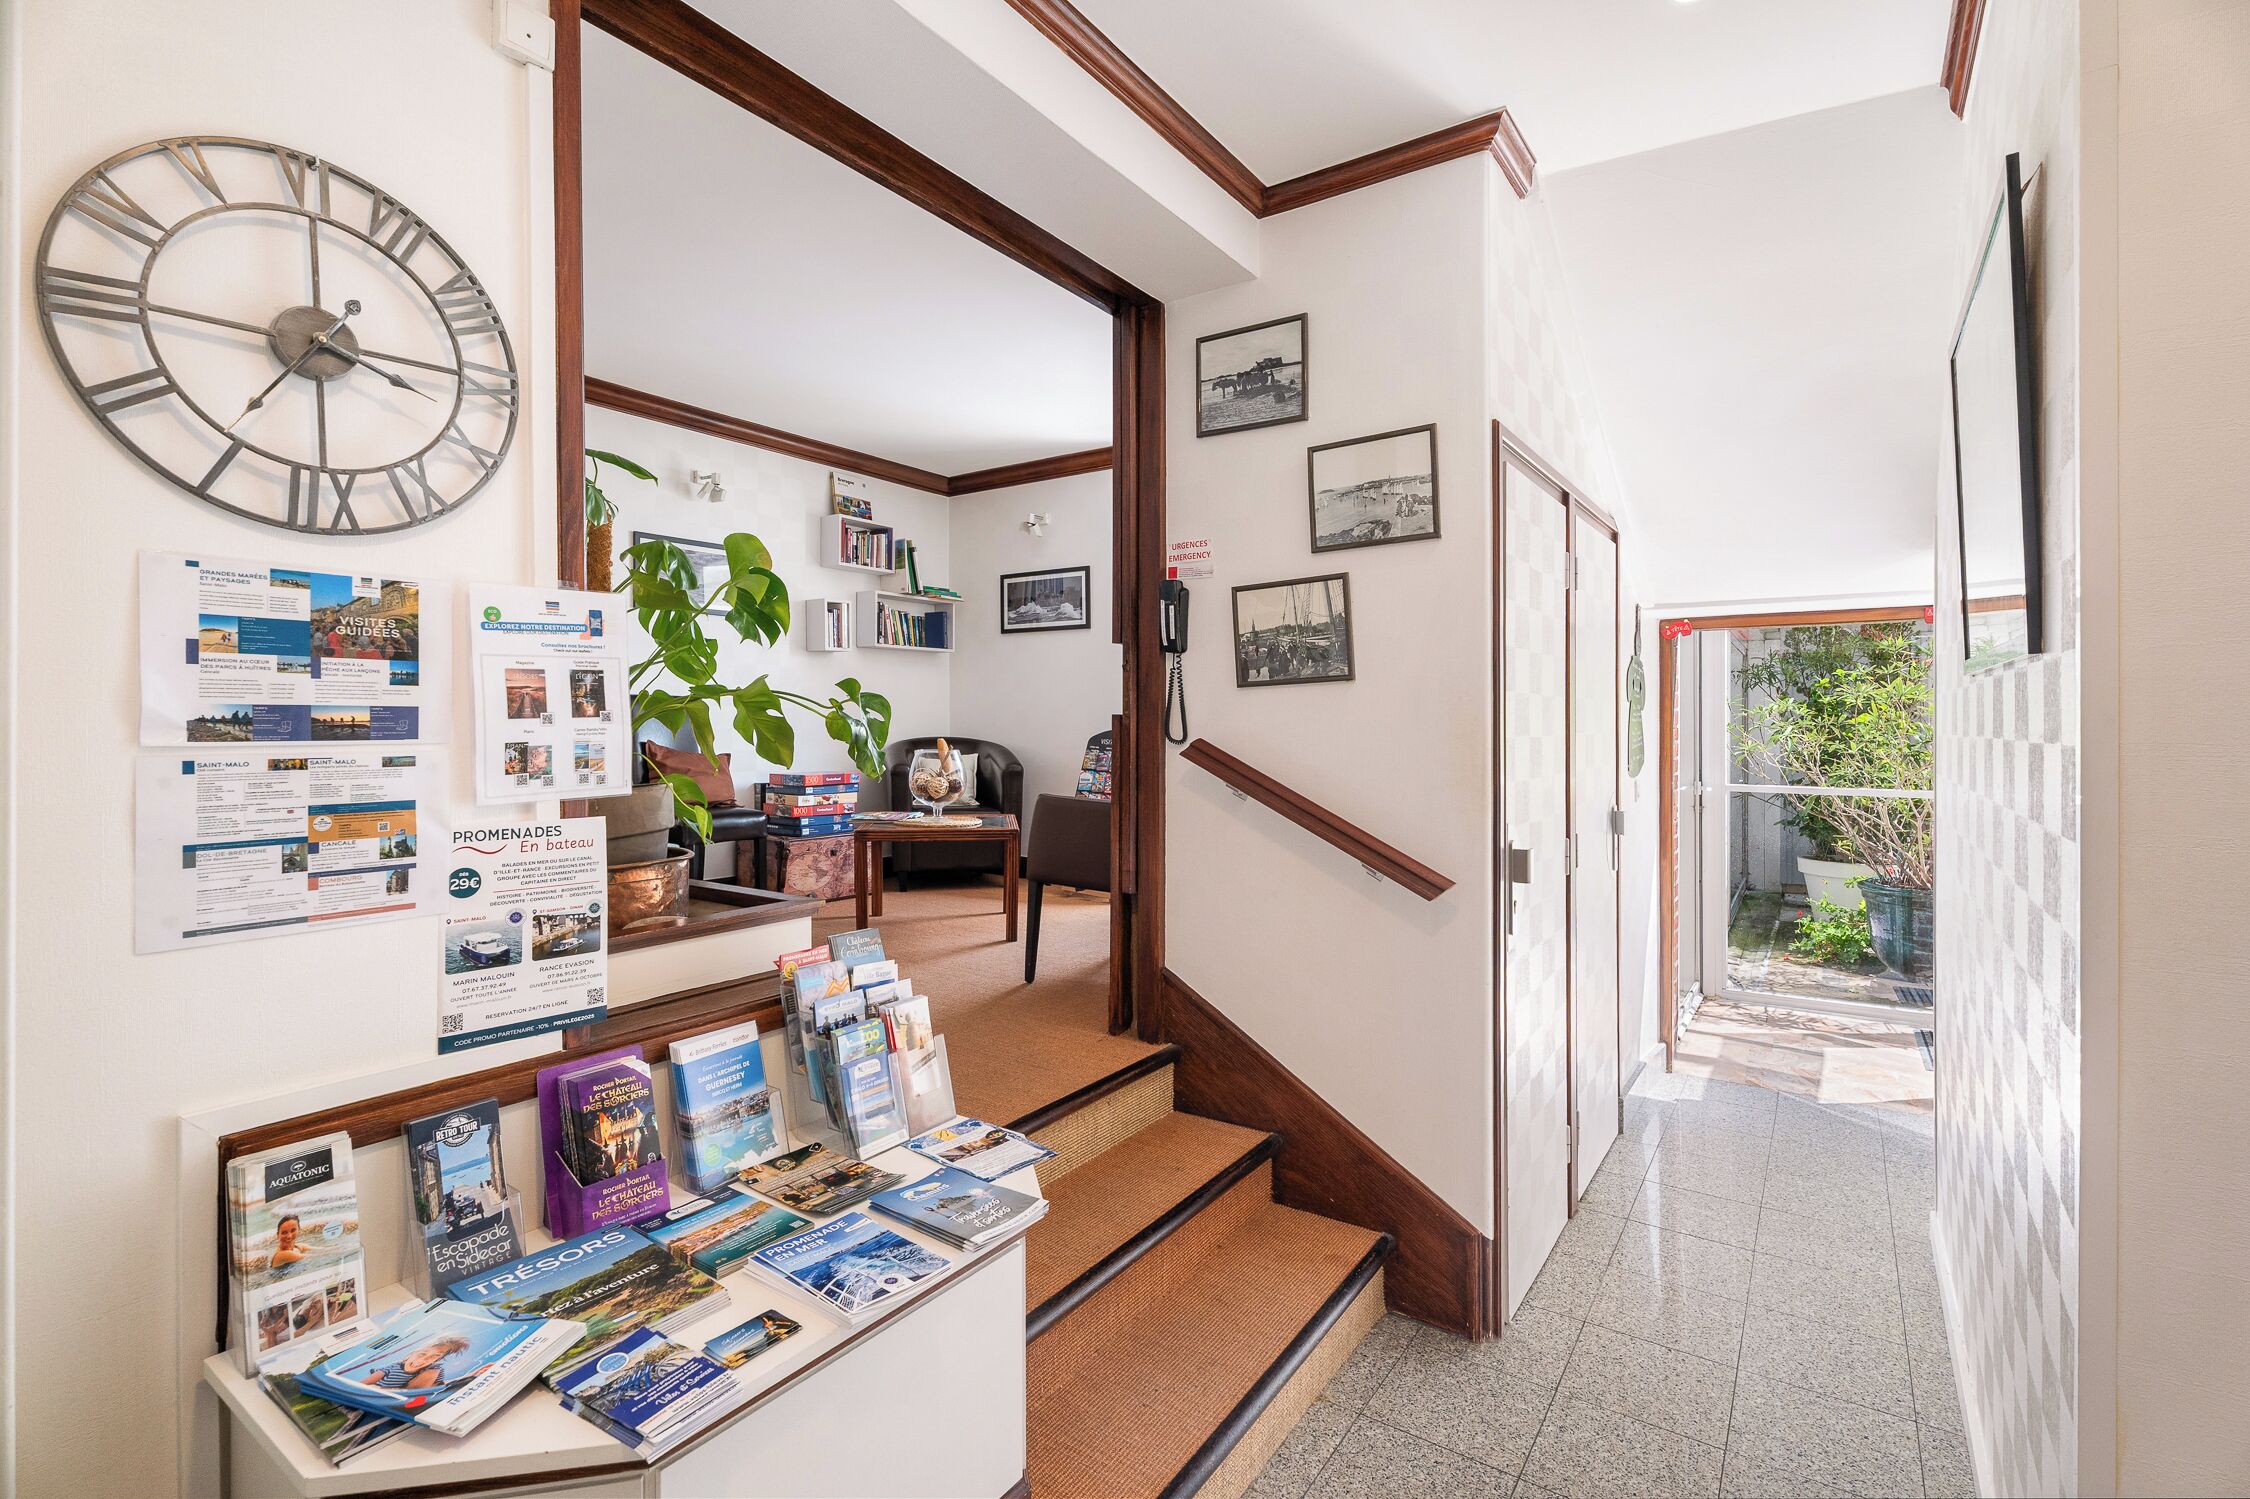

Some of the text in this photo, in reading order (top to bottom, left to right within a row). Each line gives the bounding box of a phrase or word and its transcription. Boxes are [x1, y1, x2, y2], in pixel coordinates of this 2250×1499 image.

[1172, 540, 1207, 550] URGENCES
[1169, 551, 1211, 562] EMERGENCY
[200, 569, 237, 577] GRANDES
[340, 616, 396, 628] VISITES
[335, 625, 400, 638] GUIDÉES
[806, 776, 819, 784] 1500
[794, 808, 808, 817] 1000
[453, 825, 562, 843] PROMENADES
[520, 838, 594, 853] En bateau
[197, 849, 268, 859] DOL-DE-BRETAGNE
[545, 863, 578, 871] EXCURSIONS
[320, 875, 363, 883] COMBOURG
[450, 877, 480, 891] 29€
[520, 878, 549, 886] CAPITAINE
[525, 889, 557, 897] PATRIMOINE
[846, 936, 871, 946] Château
[841, 944, 882, 958] Combourg
[453, 972, 515, 987] MARIN MALOUIN
[462, 982, 507, 993] 07.67.37.92.49
[450, 991, 494, 1003] OUVERT TOUTE
[454, 1038, 472, 1047] CODE
[473, 1033, 497, 1043] PROMO
[497, 1026, 535, 1038] PARTENAIRE
[698, 1074, 712, 1083] DANS
[713, 1065, 742, 1078] L'ARCHIPEL
[706, 1071, 745, 1091] GUERNESEY
[583, 1088, 649, 1113] DES SORCIERS
[589, 1093, 601, 1102] LE
[436, 1121, 478, 1141] RETRO TOUR
[269, 1164, 330, 1189] AQUATONIC
[592, 1207, 611, 1220] DES
[614, 1187, 664, 1212] SORCIERS
[599, 1197, 610, 1208] LE
[432, 1224, 509, 1261] Escapade
[766, 1220, 848, 1257] PROMENADE
[437, 1239, 511, 1272] en Sidecar
[774, 1238, 828, 1261] EN MER
[461, 1251, 511, 1275] VINTAGE
[467, 1231, 626, 1295] TRÉSORS
[540, 1301, 574, 1318] rtez
[583, 1264, 659, 1298] l'aventure
[447, 1336, 543, 1406] instant nautic
